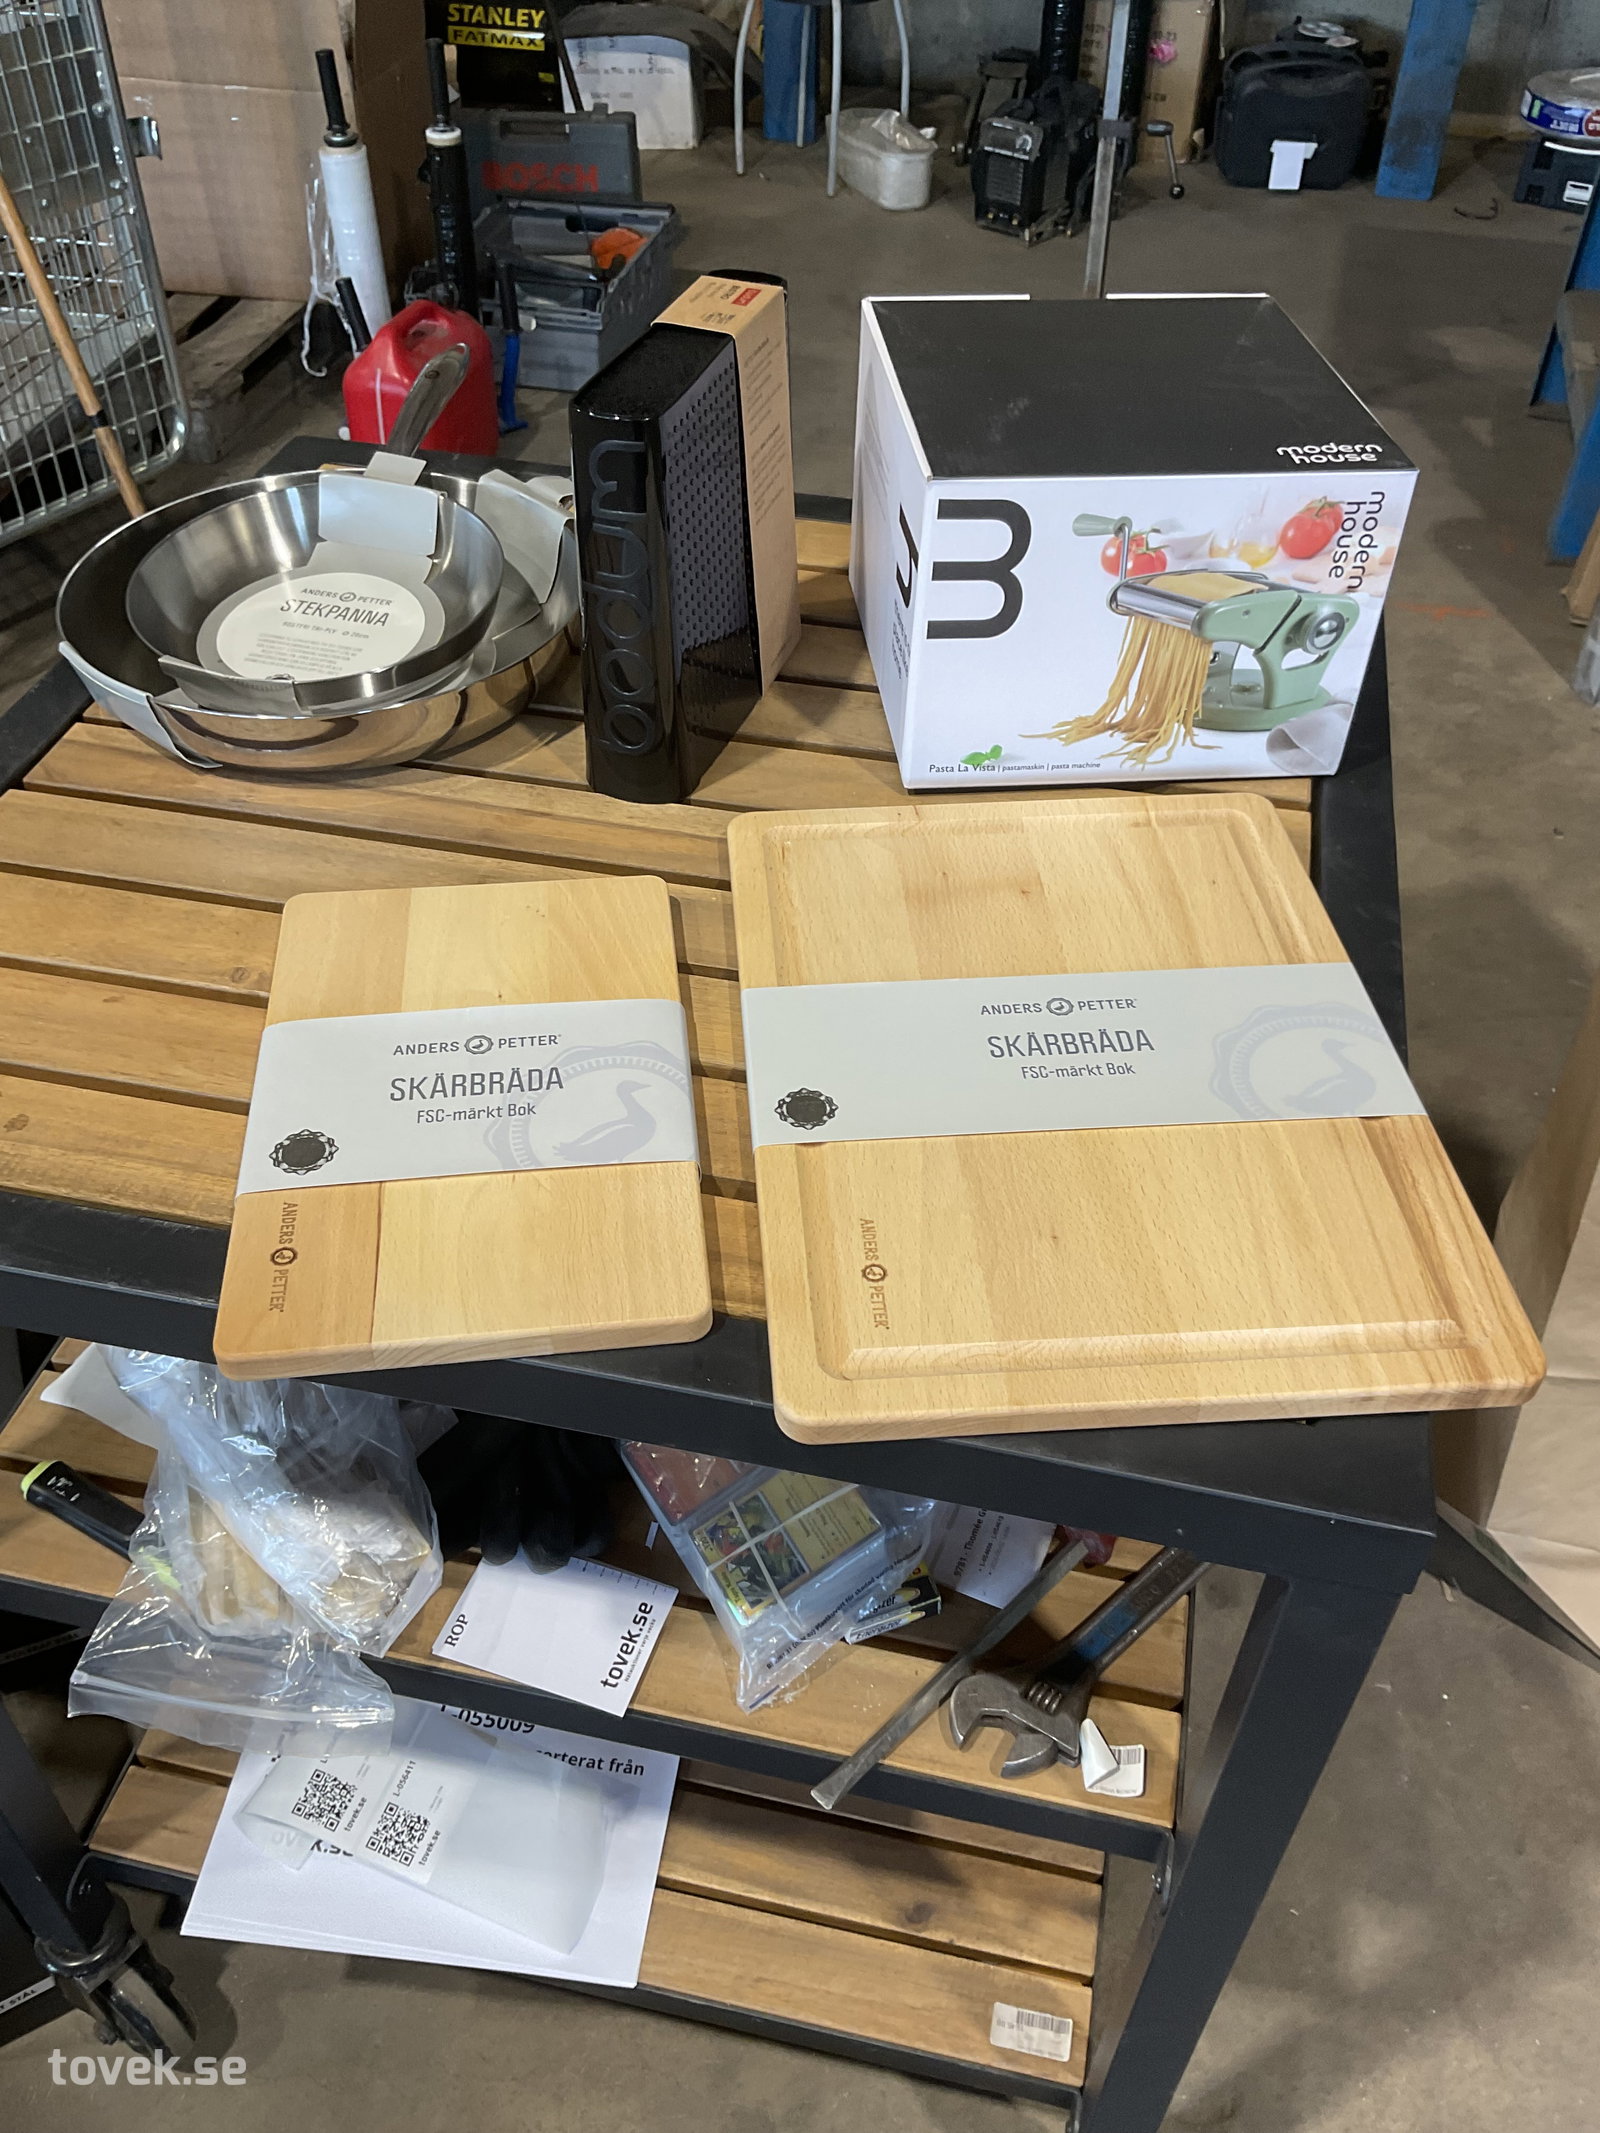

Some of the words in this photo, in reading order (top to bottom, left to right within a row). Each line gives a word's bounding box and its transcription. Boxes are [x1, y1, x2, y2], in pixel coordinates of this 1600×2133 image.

[447, 4, 545, 28] STANLEY
[453, 31, 538, 47] FATMAX
[481, 161, 599, 192] BOSCH
[1276, 442, 1383, 456] modern
[1291, 452, 1378, 464] house
[1328, 501, 1367, 578] house
[1347, 491, 1386, 589] modern
[280, 598, 391, 627] STEKPANNA
[300, 588, 339, 599] ANDERS
[357, 595, 393, 607] PETTER
[929, 764, 955, 773] Pasta
[957, 763, 969, 772] La
[973, 762, 996, 772] Vista
[1002, 763, 1045, 773] pastamaskin
[1051, 763, 1069, 772] pasta
[1071, 761, 1101, 770] machine
[981, 1002, 1043, 1015] ANDERS
[393, 1041, 460, 1056] ANDERS
[987, 1028, 1156, 1058] SKÄRBRÄDA
[390, 1066, 565, 1103] SKÄRBRÄDA
[1021, 1064, 1105, 1080] FSC-märkt
[1106, 1061, 1137, 1076] Bok
[416, 1105, 503, 1124] FSC-märkt
[507, 1102, 538, 1118] Bok
[278, 1201, 299, 1245] ANDERS
[859, 1217, 880, 1261] ANDERS
[269, 1268, 290, 1311] PETTER
[869, 1285, 889, 1329] PETTER
[964, 1519, 985, 1550] Thomée
[444, 1613, 469, 1648] ROP
[601, 1601, 654, 1689] tovek.se
[393, 1760, 417, 1798] L-056411
[608, 1756, 646, 1777] från
[344, 1797, 367, 1832] tovek.se
[418, 1830, 441, 1866] tovek.se
